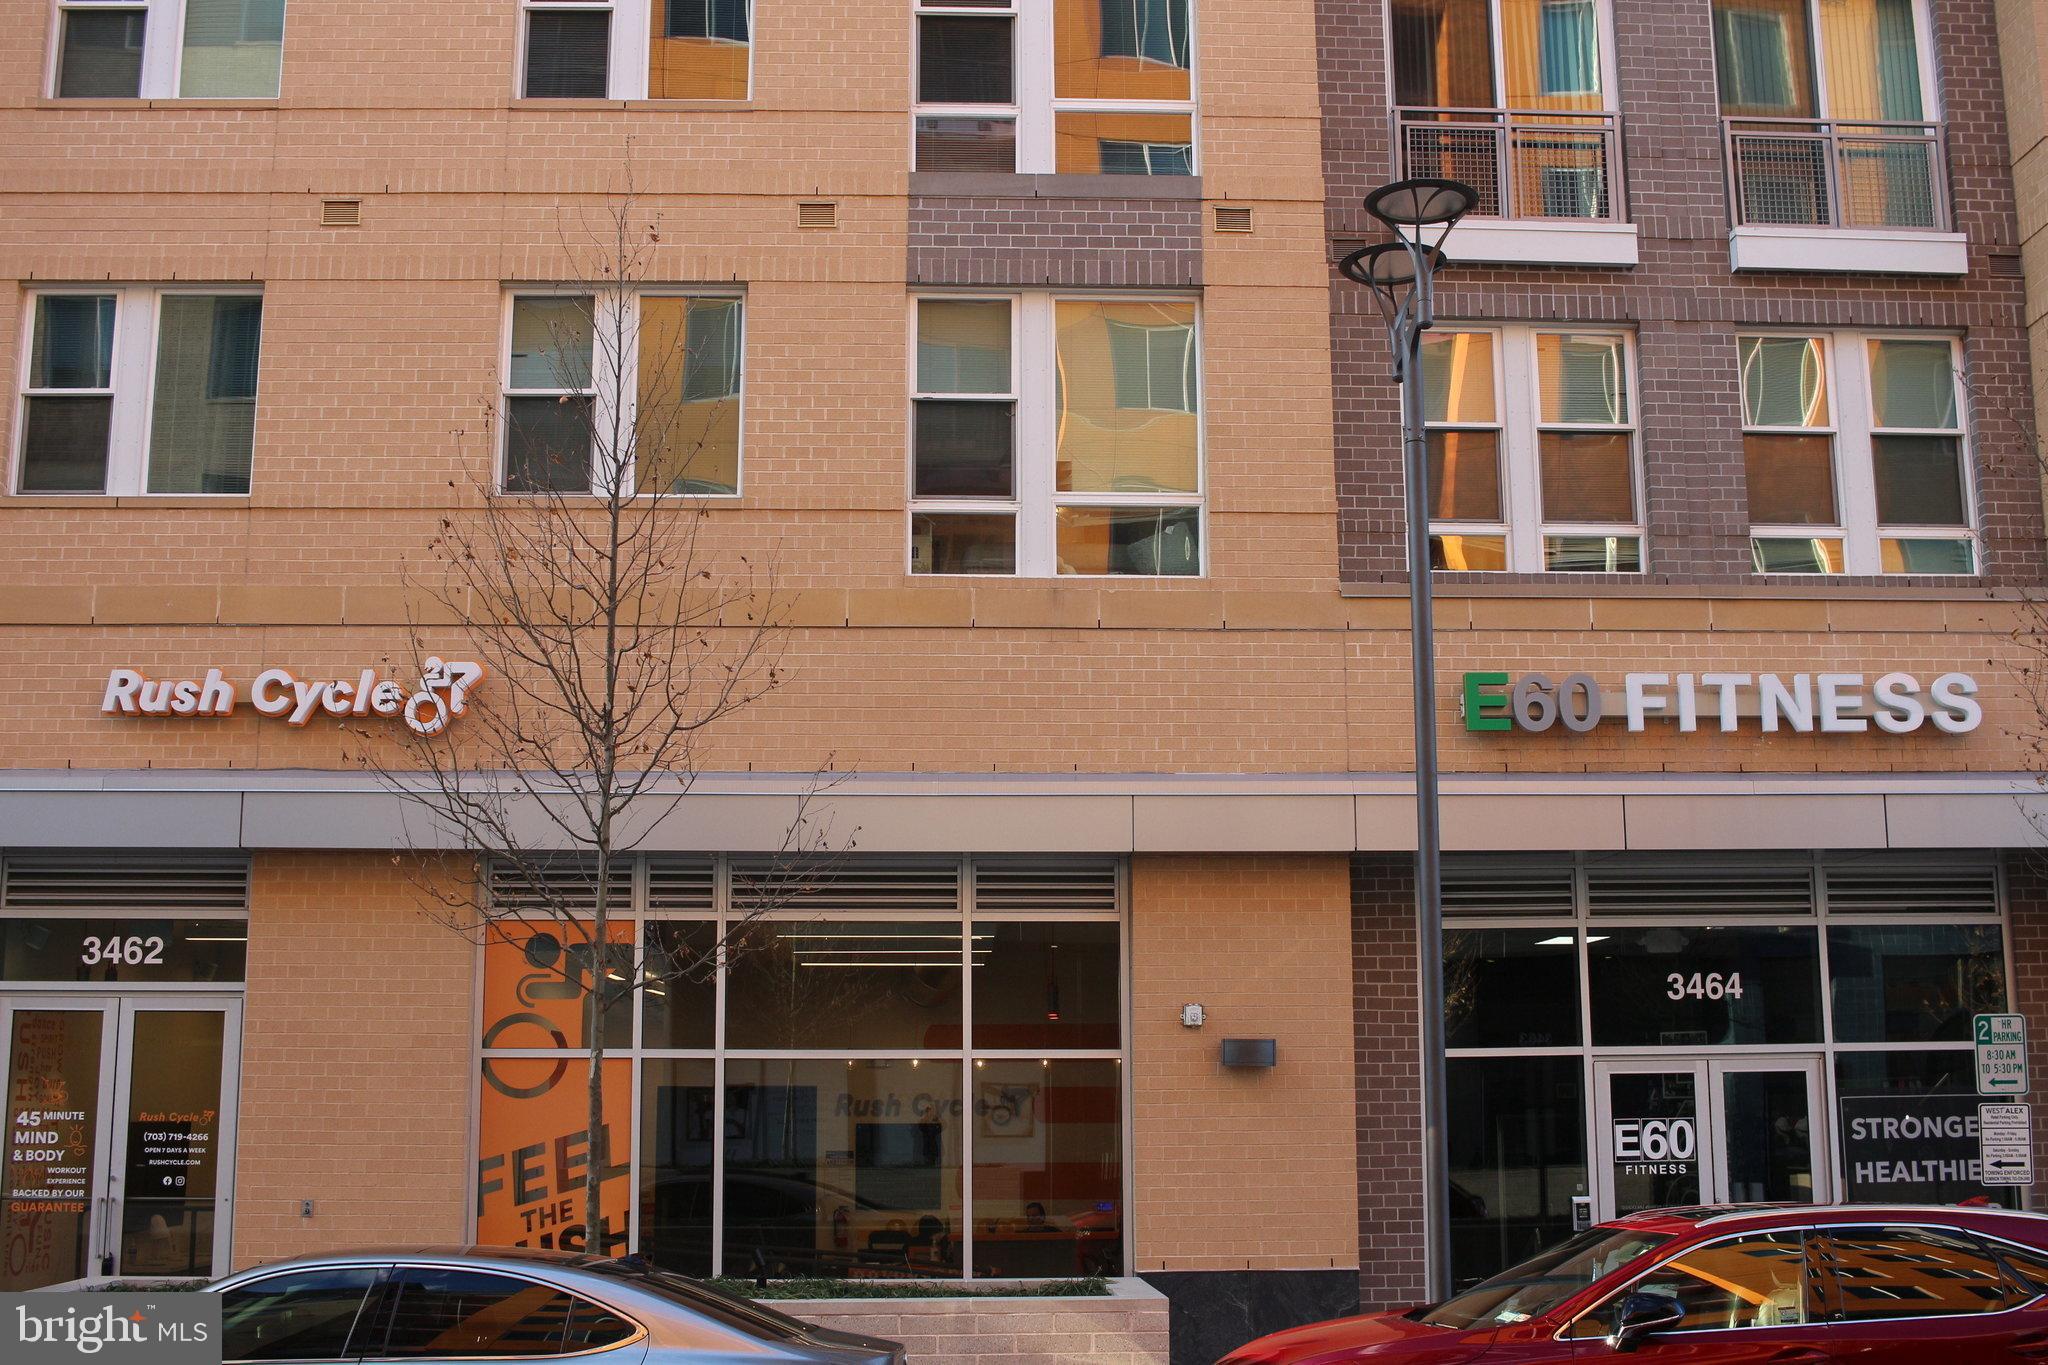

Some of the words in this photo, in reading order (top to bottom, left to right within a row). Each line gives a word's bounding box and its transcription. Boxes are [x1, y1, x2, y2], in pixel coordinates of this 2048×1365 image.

[102, 669, 233, 715] Rush
[251, 668, 404, 726] Cycle
[1464, 672, 1602, 733] E60
[1625, 673, 1983, 734] FITNESS
[82, 936, 164, 965] 3462
[1666, 972, 1744, 1001] 3464
[1978, 1021, 1989, 1040] 2
[2001, 1019, 2012, 1029] HR
[1993, 1031, 2022, 1042] PARKING
[1986, 1049, 2004, 1060] 8:30
[2005, 1050, 2016, 1060] AM
[1981, 1064, 1990, 1074] TO
[1994, 1063, 2011, 1074] 5:30
[2012, 1064, 2023, 1073] PM
[836, 1093, 901, 1117] Rush
[912, 1093, 988, 1119] Cyce
[16, 1111, 41, 1126] 45
[43, 1111, 85, 1120] MINUTE
[139, 1112, 165, 1122] Rush
[169, 1112, 199, 1124] Cycle
[1851, 1115, 1979, 1140] STRONGE
[15, 1131, 59, 1144] MIND
[143, 1132, 167, 1142] (703)
[168, 1133, 209, 1141] 719-4266
[1615, 1119, 1695, 1160] E60
[13, 1150, 23, 1161] &
[26, 1150, 65, 1161] BODY
[478, 1123, 630, 1217] FEEL
[1625, 1164, 1687, 1175] FITNESS
[1855, 1159, 1981, 1184] HEALTHIE
[12, 1189, 50, 1197] BACKED
[52, 1189, 64, 1197] BY
[65, 1189, 85, 1197] OUR
[11, 1202, 84, 1213] GUARANTEE
[520, 1199, 574, 1233] THE
